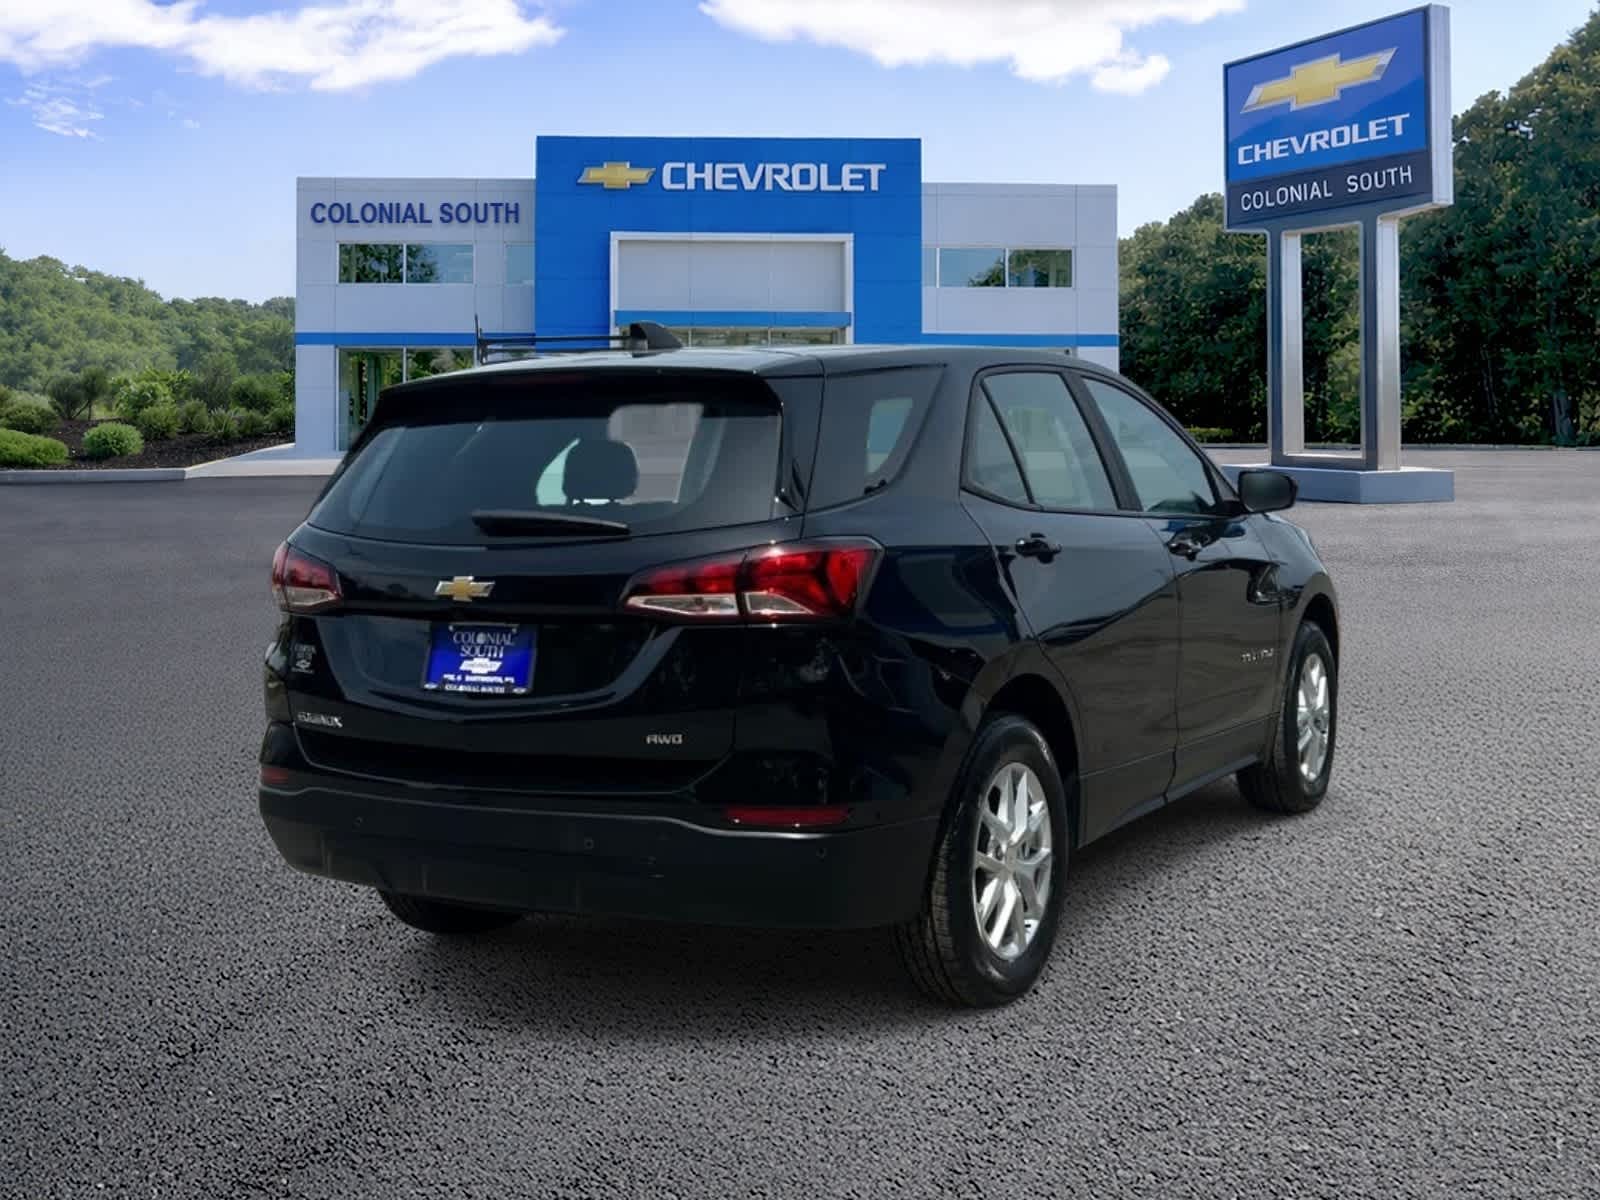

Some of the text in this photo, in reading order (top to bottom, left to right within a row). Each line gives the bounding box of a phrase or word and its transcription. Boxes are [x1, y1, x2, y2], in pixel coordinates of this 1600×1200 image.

[1237, 112, 1410, 165] CHEVROLET
[662, 162, 886, 191] CHEVROLET
[1240, 165, 1412, 211] COLONIAL SOUTH
[310, 202, 520, 224] COLONIAL SOUTH
[453, 631, 515, 646] COLONIAL
[460, 645, 504, 658] SOUTH
[646, 734, 683, 745] AWD
